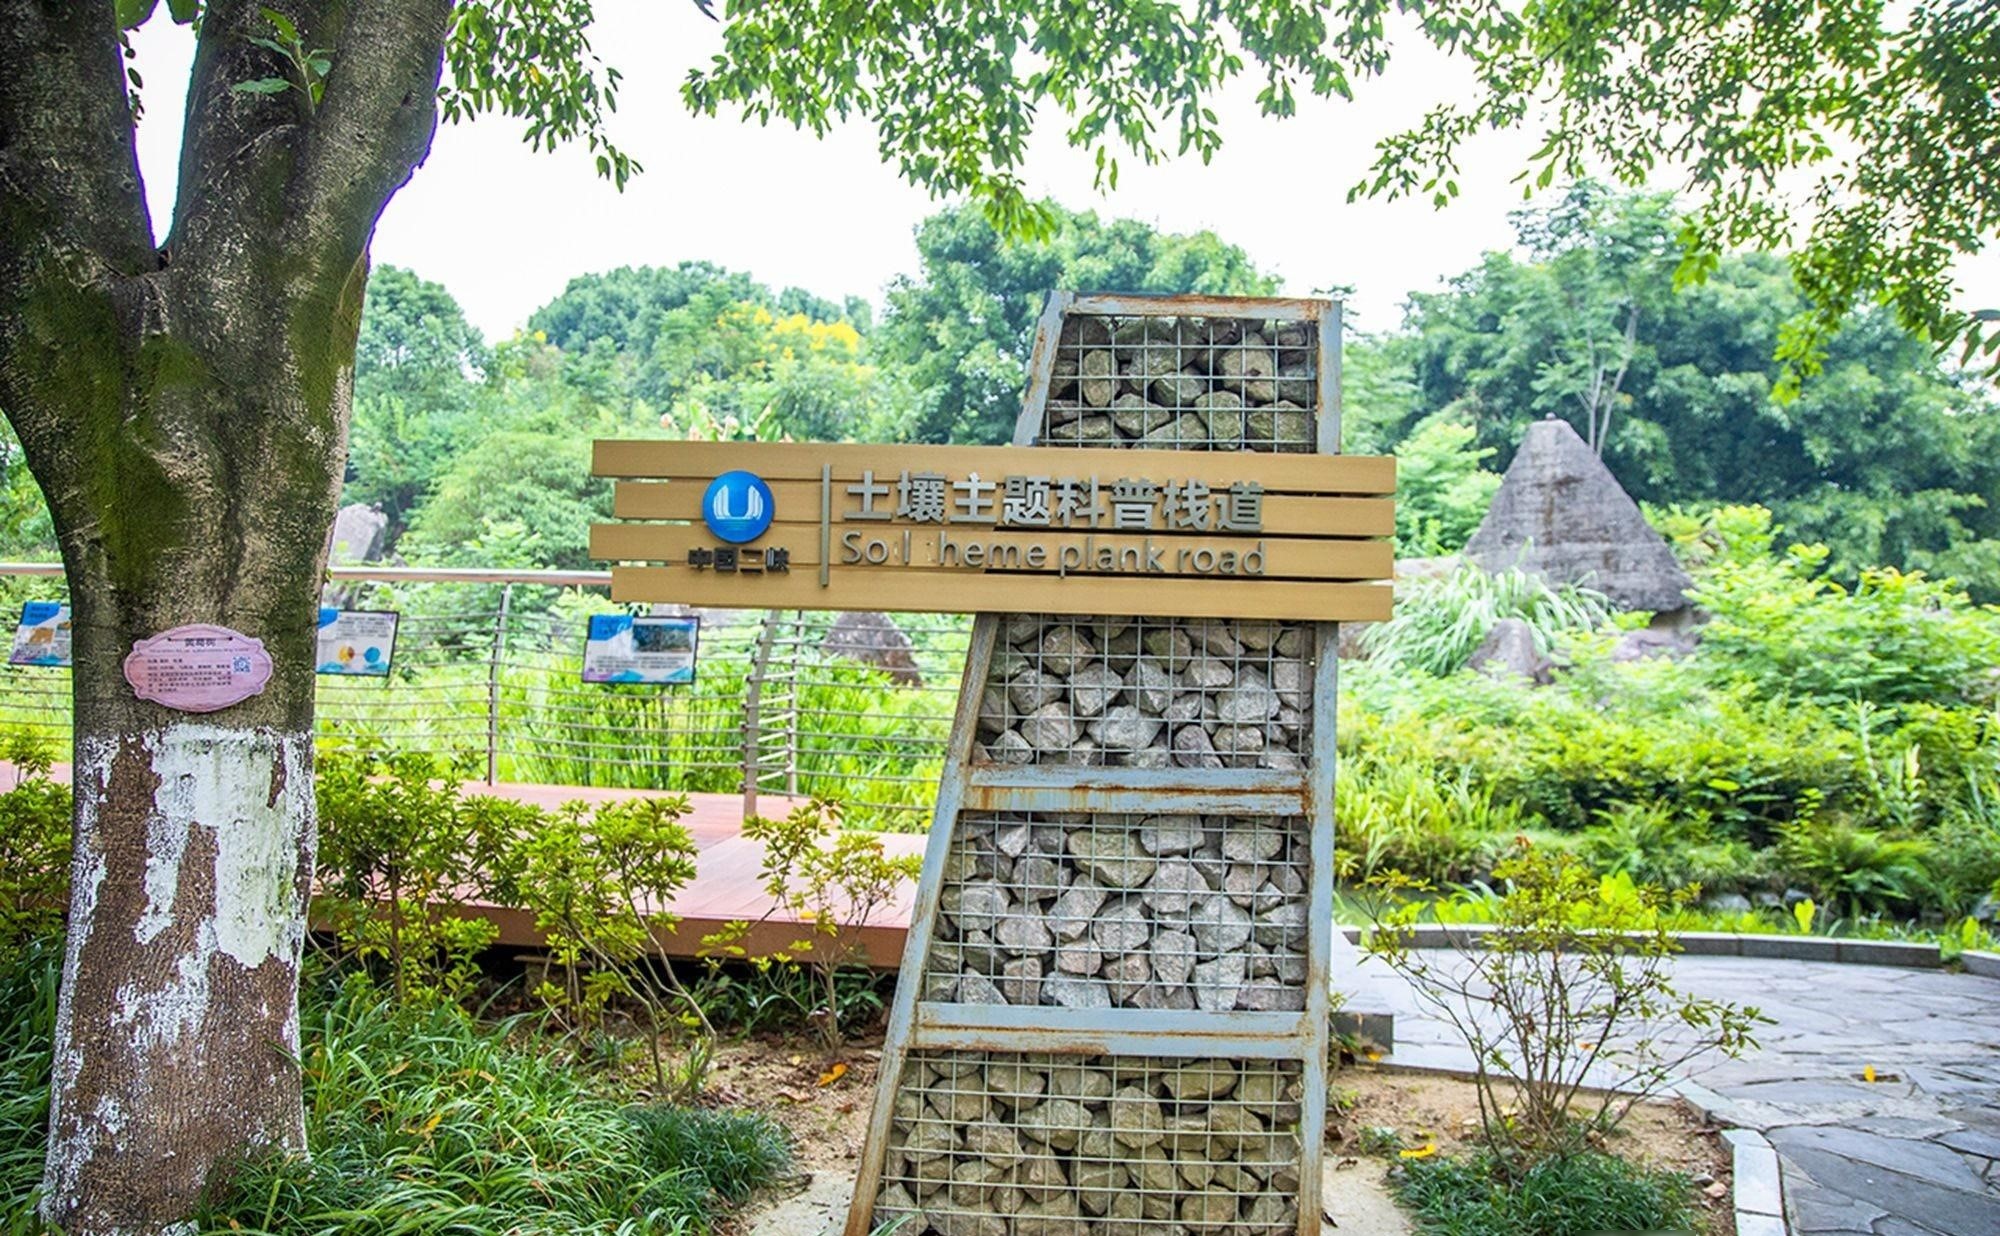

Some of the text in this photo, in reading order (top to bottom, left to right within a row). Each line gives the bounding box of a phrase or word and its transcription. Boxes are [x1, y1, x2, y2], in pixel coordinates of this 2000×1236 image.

[843, 469, 1265, 532] 土壤主题科普栈道
[841, 529, 1266, 579] Sol heme plank road
